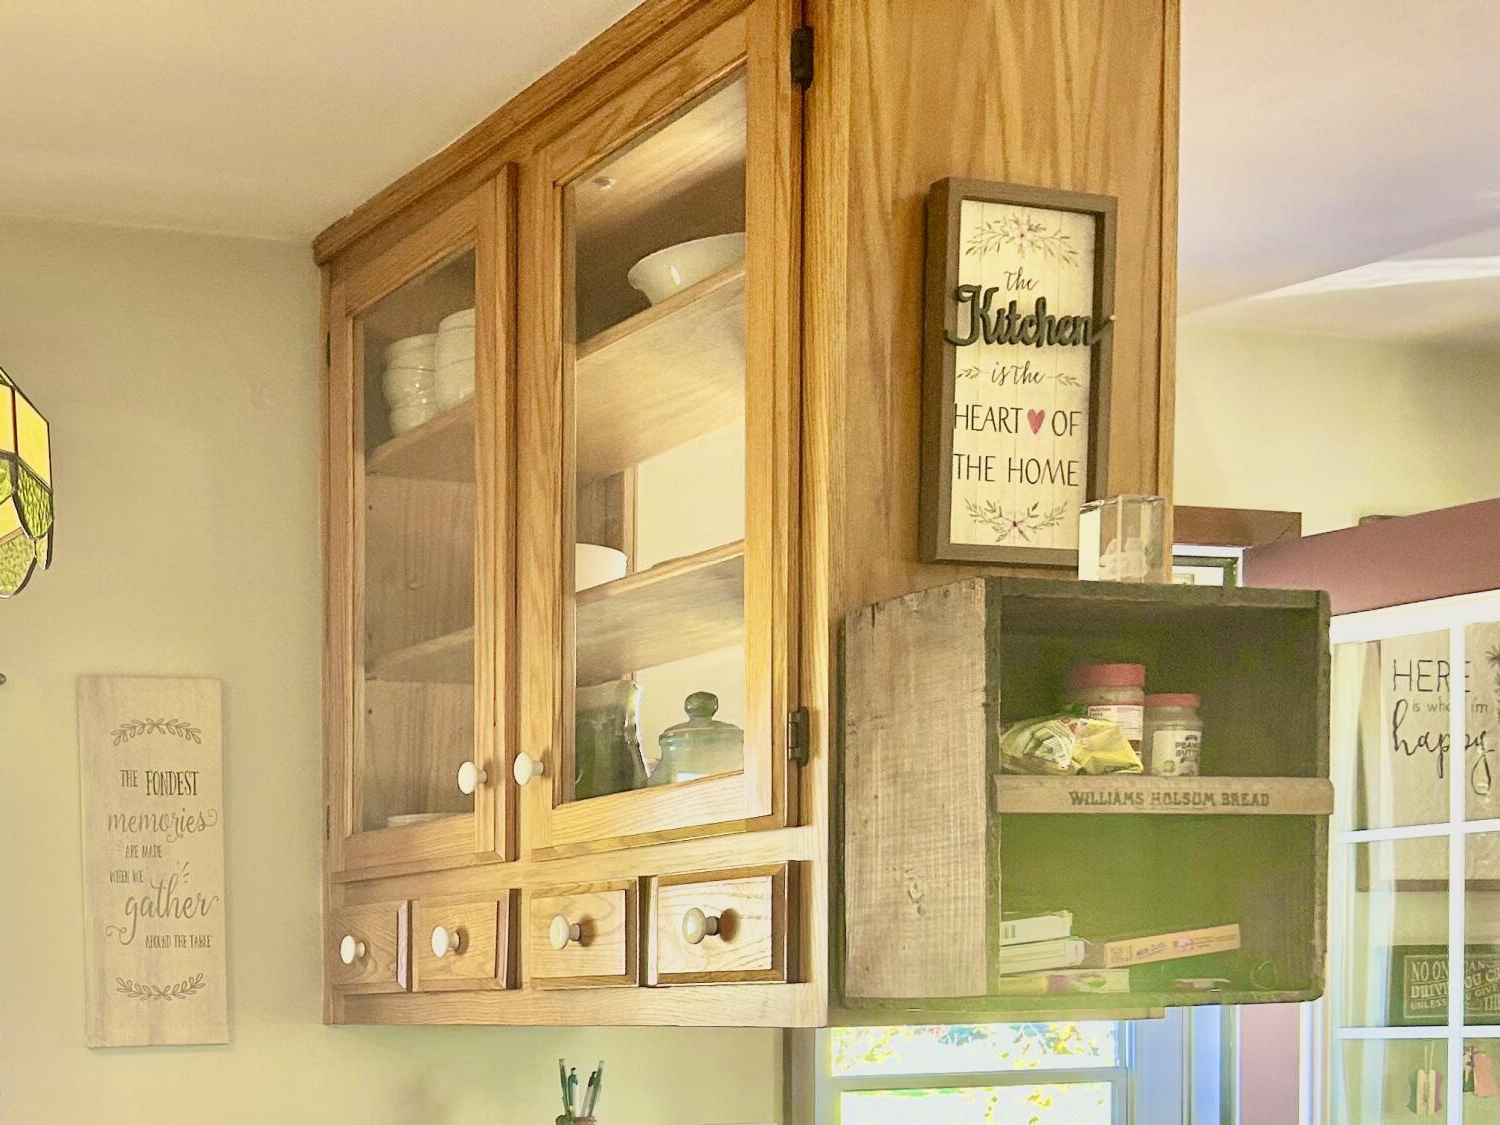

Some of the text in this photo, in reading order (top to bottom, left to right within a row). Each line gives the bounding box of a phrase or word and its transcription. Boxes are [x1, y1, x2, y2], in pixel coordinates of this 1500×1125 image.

[944, 284, 1117, 348] Kitchen
[990, 361, 1006, 387] is
[954, 403, 1083, 437] HEART OF
[953, 453, 1080, 487] THE HOME
[1428, 695, 1453, 713] whe
[1175, 741, 1200, 750] PEAN
[1175, 749, 1200, 758] BUTT
[119, 769, 200, 796] THE FONDEST
[1068, 791, 1145, 807] WILLIAMS
[1221, 792, 1270, 807] BREAD
[107, 807, 218, 843] memories
[105, 872, 220, 946] gather
[1411, 961, 1430, 983] NO
[1432, 960, 1450, 981] ON
